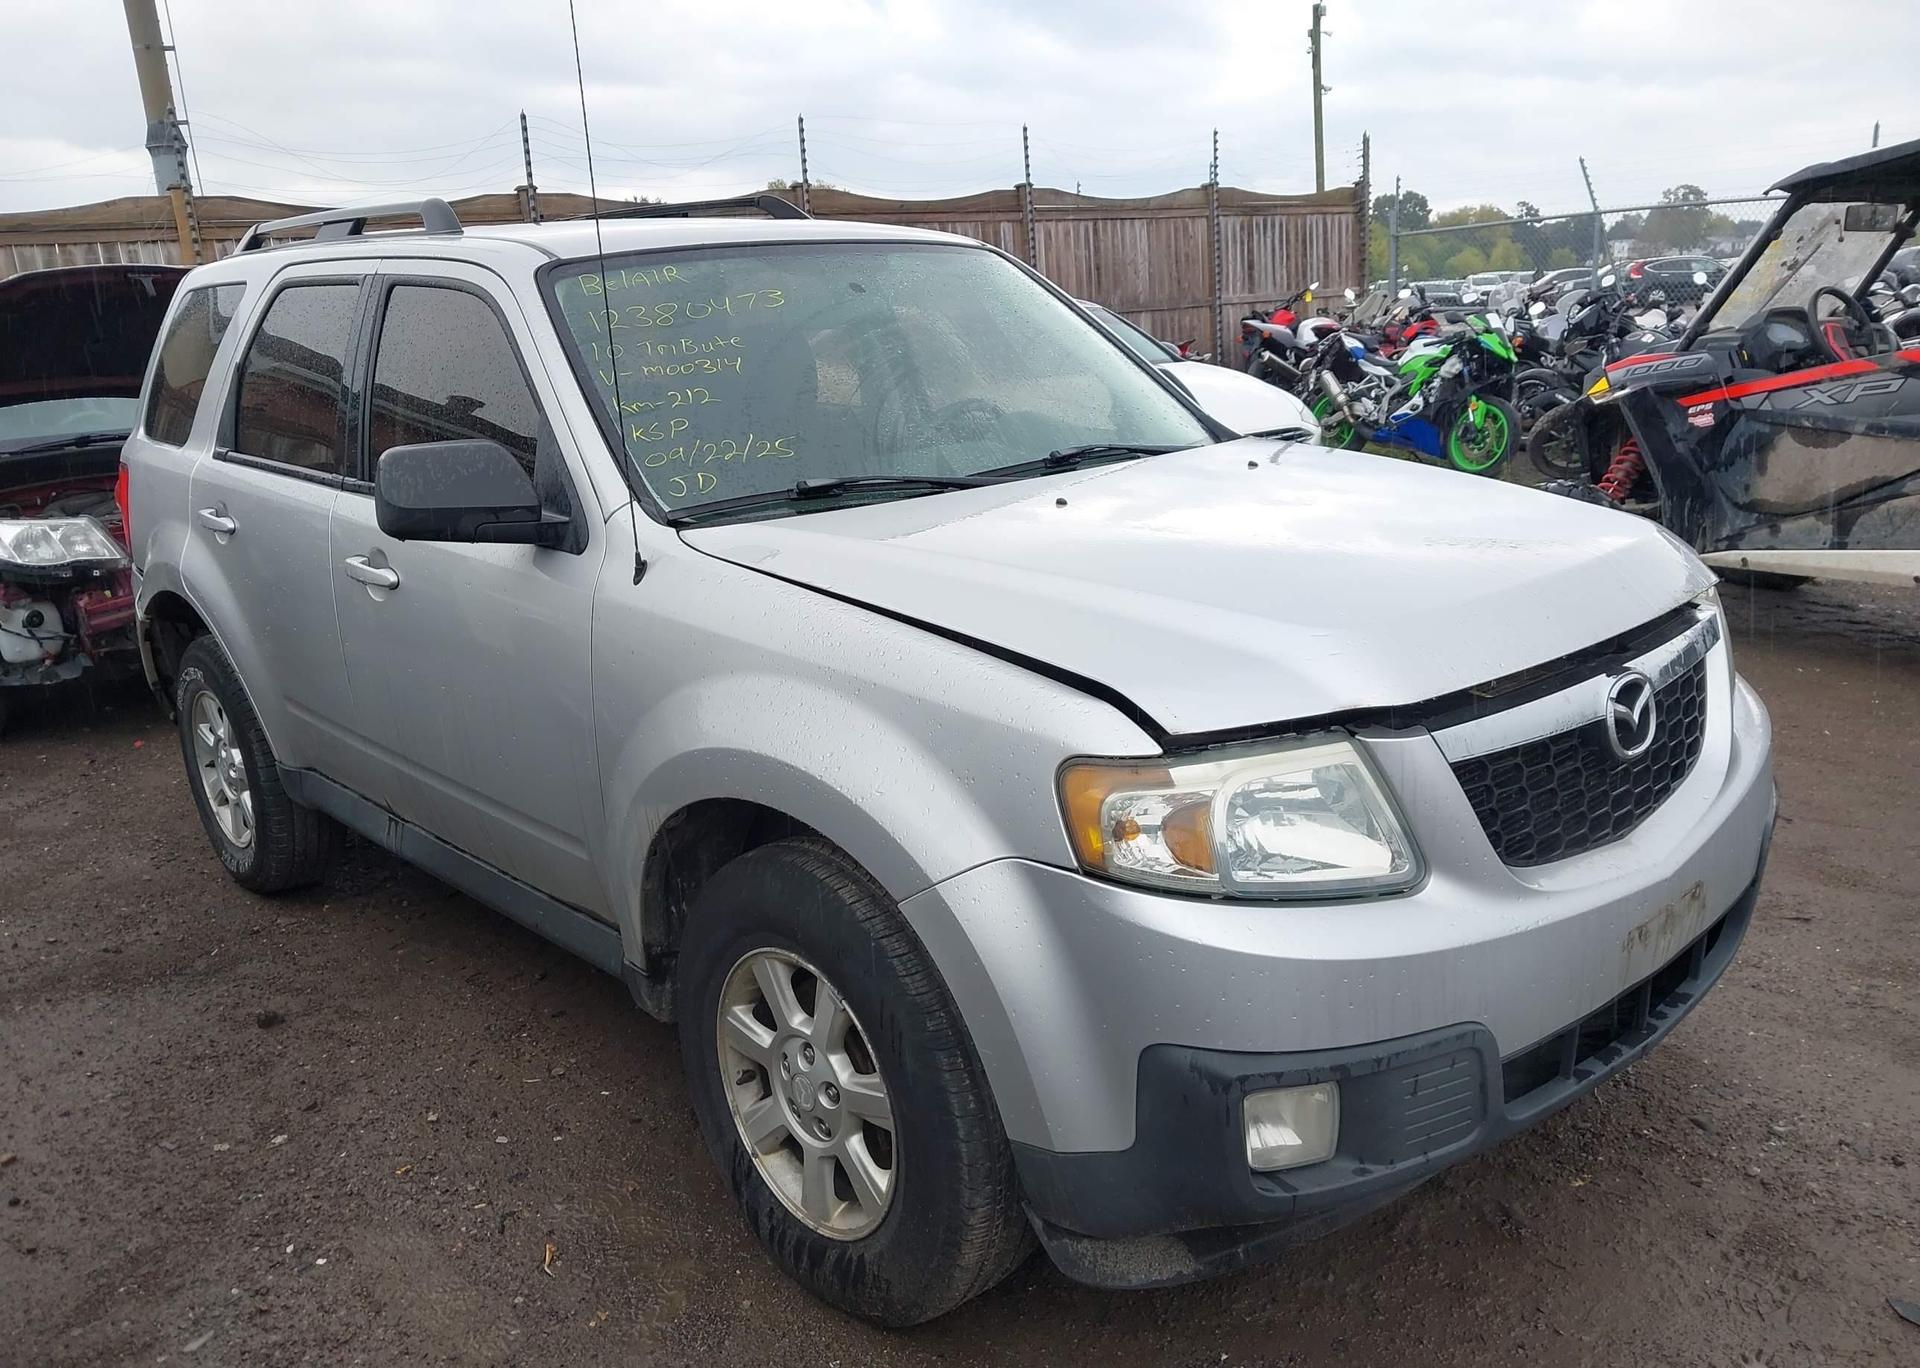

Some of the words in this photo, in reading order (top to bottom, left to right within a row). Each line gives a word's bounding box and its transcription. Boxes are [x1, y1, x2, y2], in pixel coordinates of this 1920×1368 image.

[588, 288, 785, 333] 12380473
[592, 341, 624, 361] 10
[1623, 356, 1705, 379] 1000
[1790, 376, 1908, 411] XP
[631, 418, 689, 443] KSP
[644, 432, 800, 468] 09/22/25
